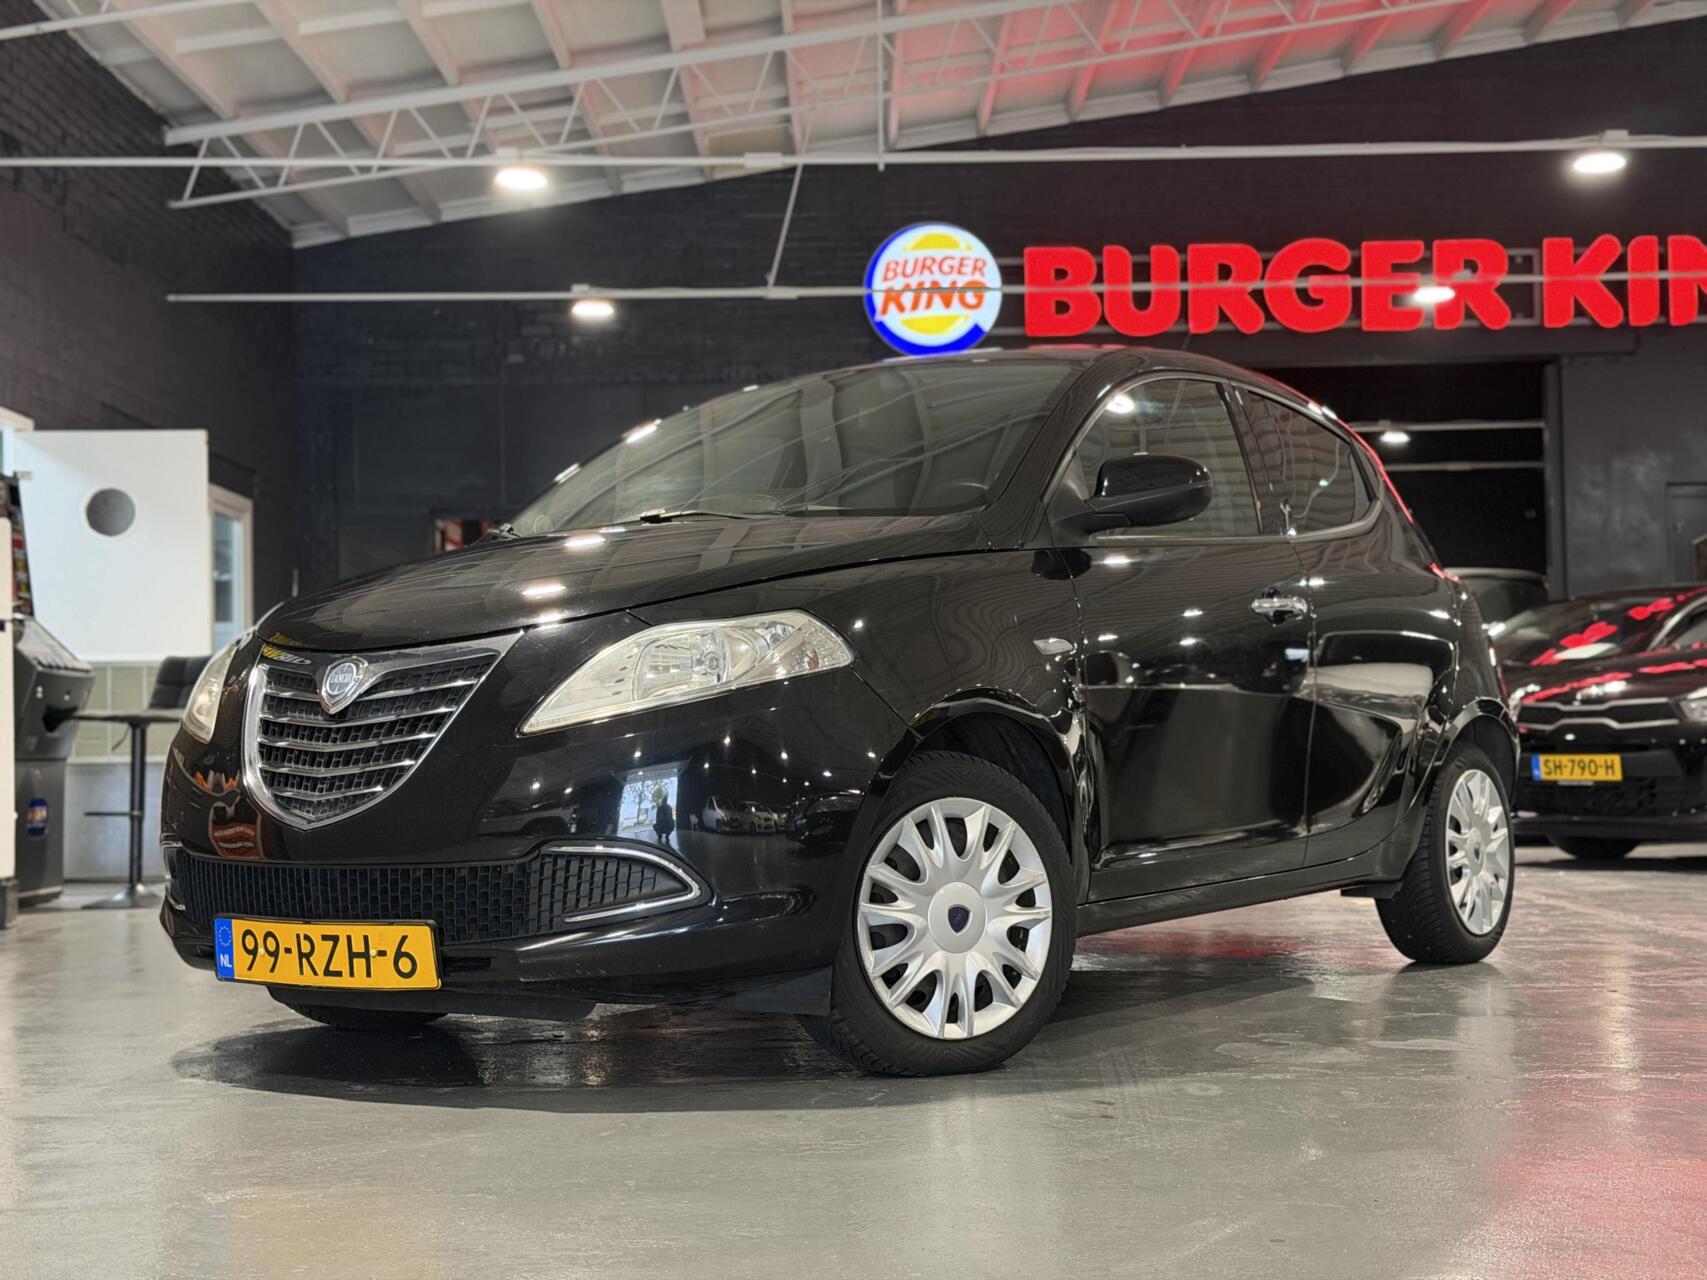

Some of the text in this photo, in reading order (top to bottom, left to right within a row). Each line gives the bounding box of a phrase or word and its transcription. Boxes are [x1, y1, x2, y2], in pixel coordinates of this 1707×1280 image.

[882, 256, 987, 282] BURGER
[880, 280, 985, 316] KING
[1024, 238, 1511, 336] BURGER
[1543, 758, 1616, 776] SH-790-H
[219, 953, 232, 968] NL
[241, 929, 418, 979] 99-RZH-6
